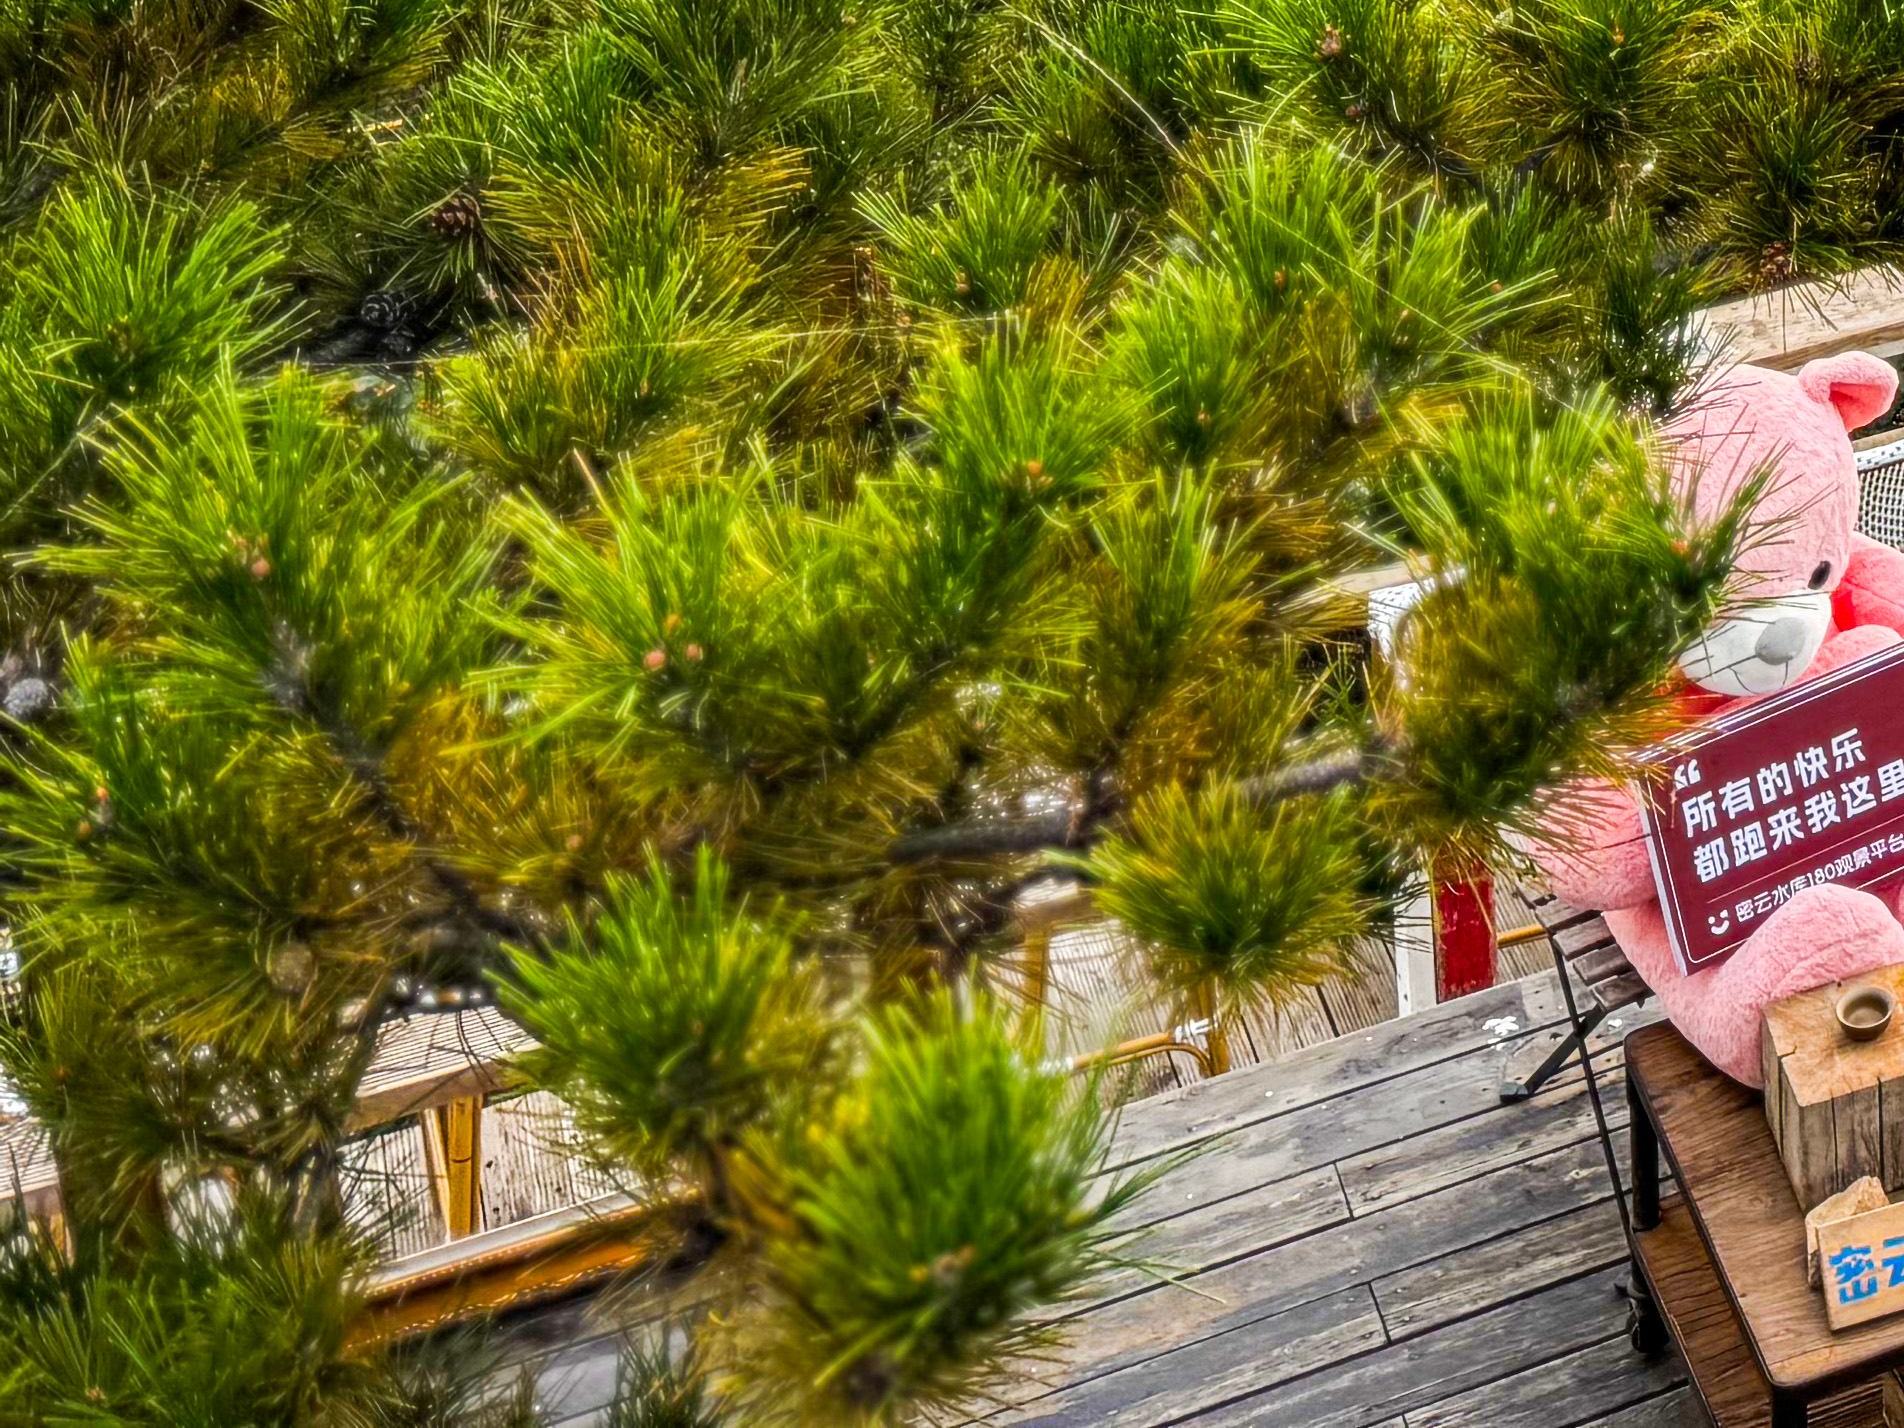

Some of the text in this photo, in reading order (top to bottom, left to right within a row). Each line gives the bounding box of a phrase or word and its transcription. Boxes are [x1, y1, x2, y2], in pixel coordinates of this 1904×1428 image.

[1682, 727, 1867, 838] 所有的快乐
